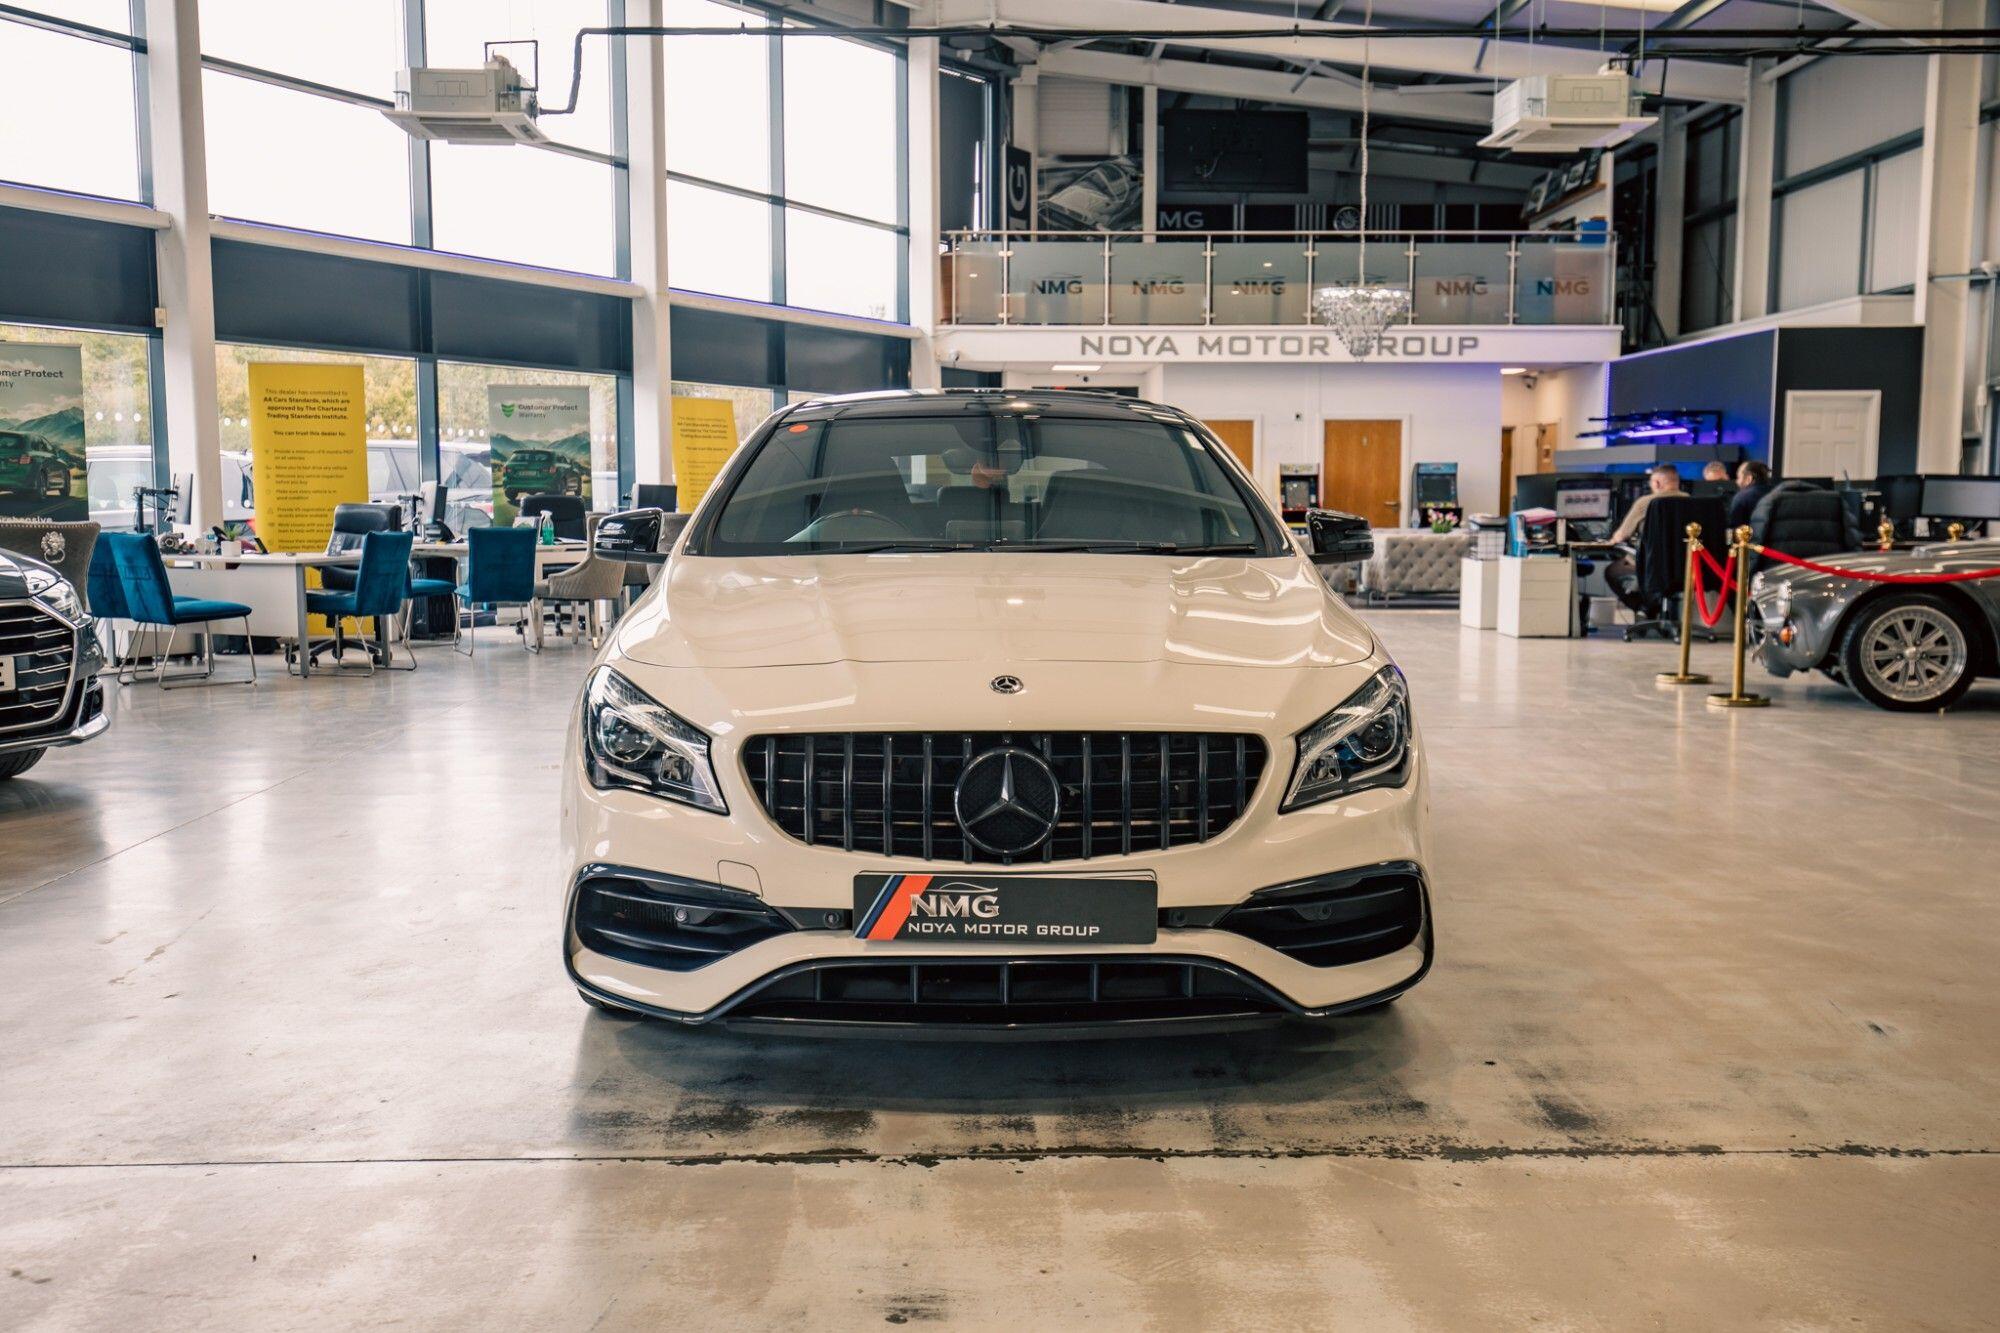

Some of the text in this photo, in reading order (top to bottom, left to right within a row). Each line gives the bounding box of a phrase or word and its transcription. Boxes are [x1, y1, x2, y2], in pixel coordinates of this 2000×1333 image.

[1160, 211, 1204, 229] MG
[1030, 280, 1083, 295] NMG
[1132, 280, 1185, 295] NMG
[1233, 280, 1286, 295] NMG
[1435, 280, 1488, 295] NMG
[1537, 280, 1590, 295] NMG
[1081, 335, 1179, 355] NOYA
[1198, 335, 1330, 356] MOTOR
[24, 369, 64, 378] Protect
[910, 894, 1000, 918] NMG
[908, 923, 1100, 937] NOYA MOTOR GROUP
